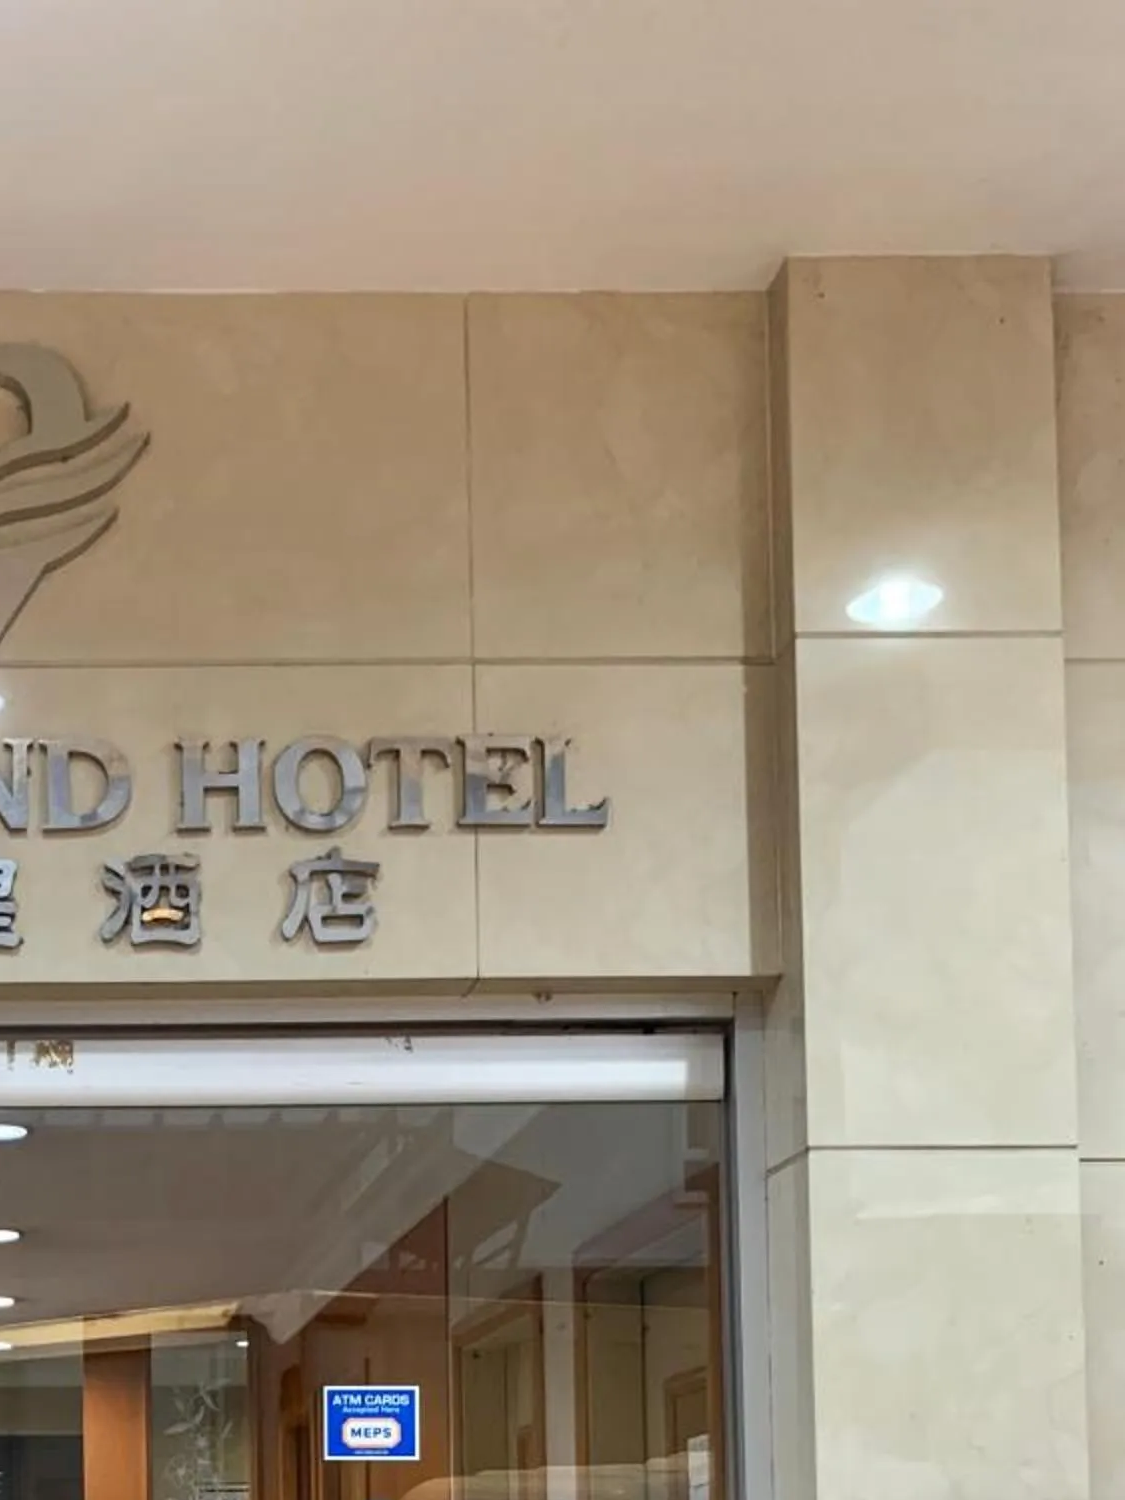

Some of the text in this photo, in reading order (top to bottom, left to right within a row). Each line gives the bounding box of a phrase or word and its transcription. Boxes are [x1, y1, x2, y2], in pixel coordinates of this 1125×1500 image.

[174, 734, 609, 833] HOTEL
[332, 1394, 410, 1405] ATM CARDS
[350, 1427, 392, 1438] MEPS
